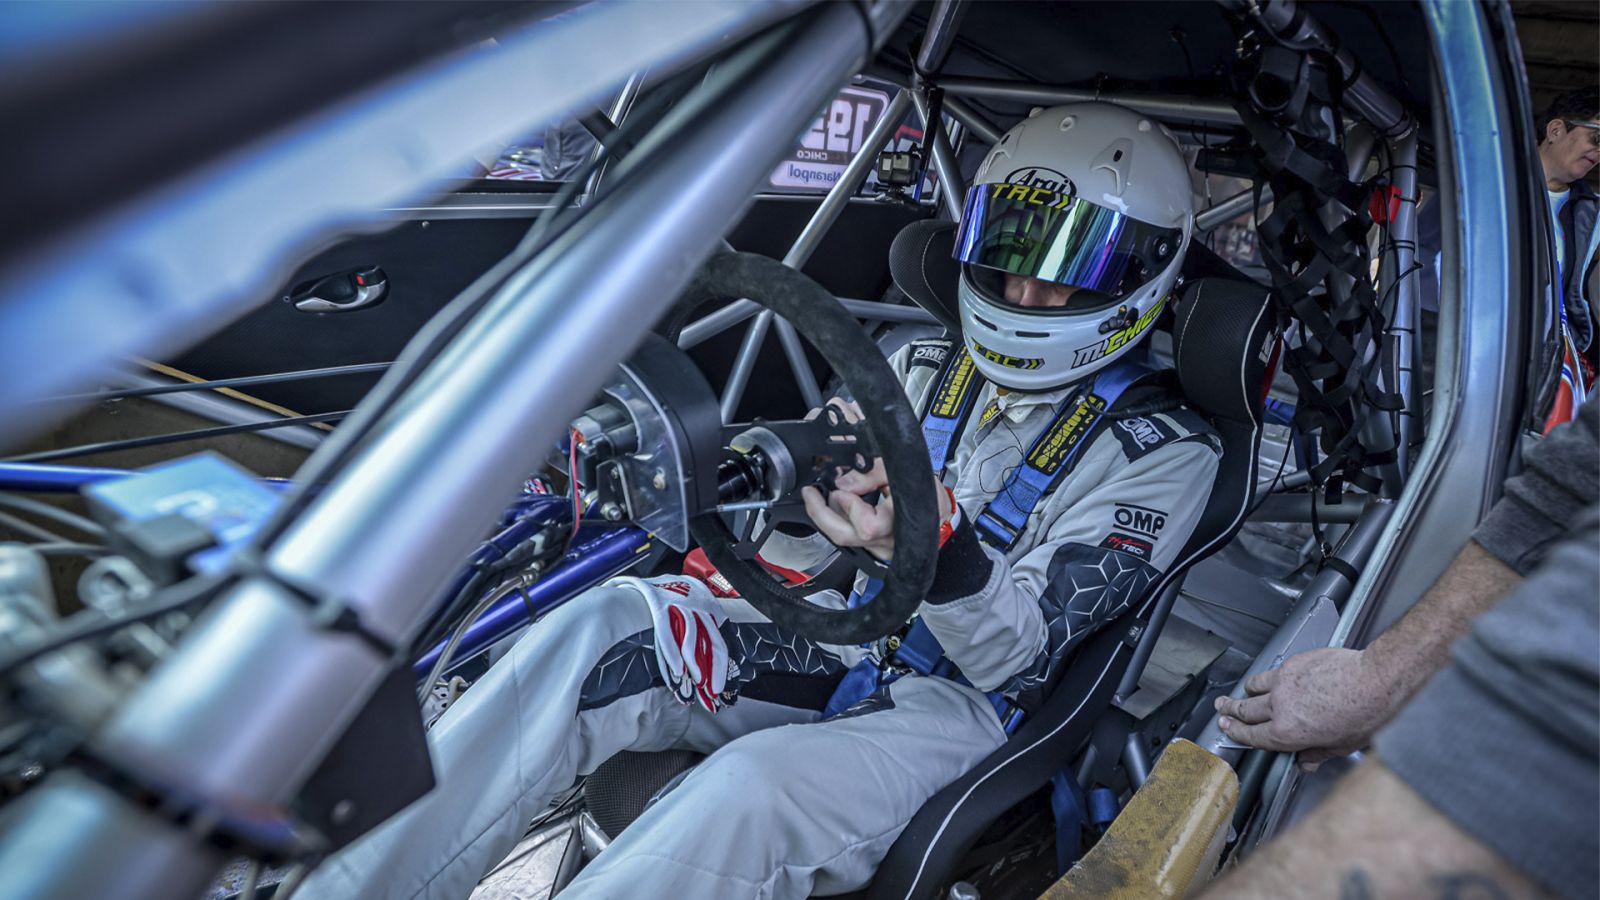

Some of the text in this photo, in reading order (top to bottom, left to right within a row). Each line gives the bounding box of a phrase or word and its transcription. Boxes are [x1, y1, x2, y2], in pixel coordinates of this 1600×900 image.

[1012, 169, 1067, 193] Arai
[939, 351, 973, 415] CHROTH
[1123, 419, 1160, 443] OMP
[1114, 508, 1165, 534] OMP
